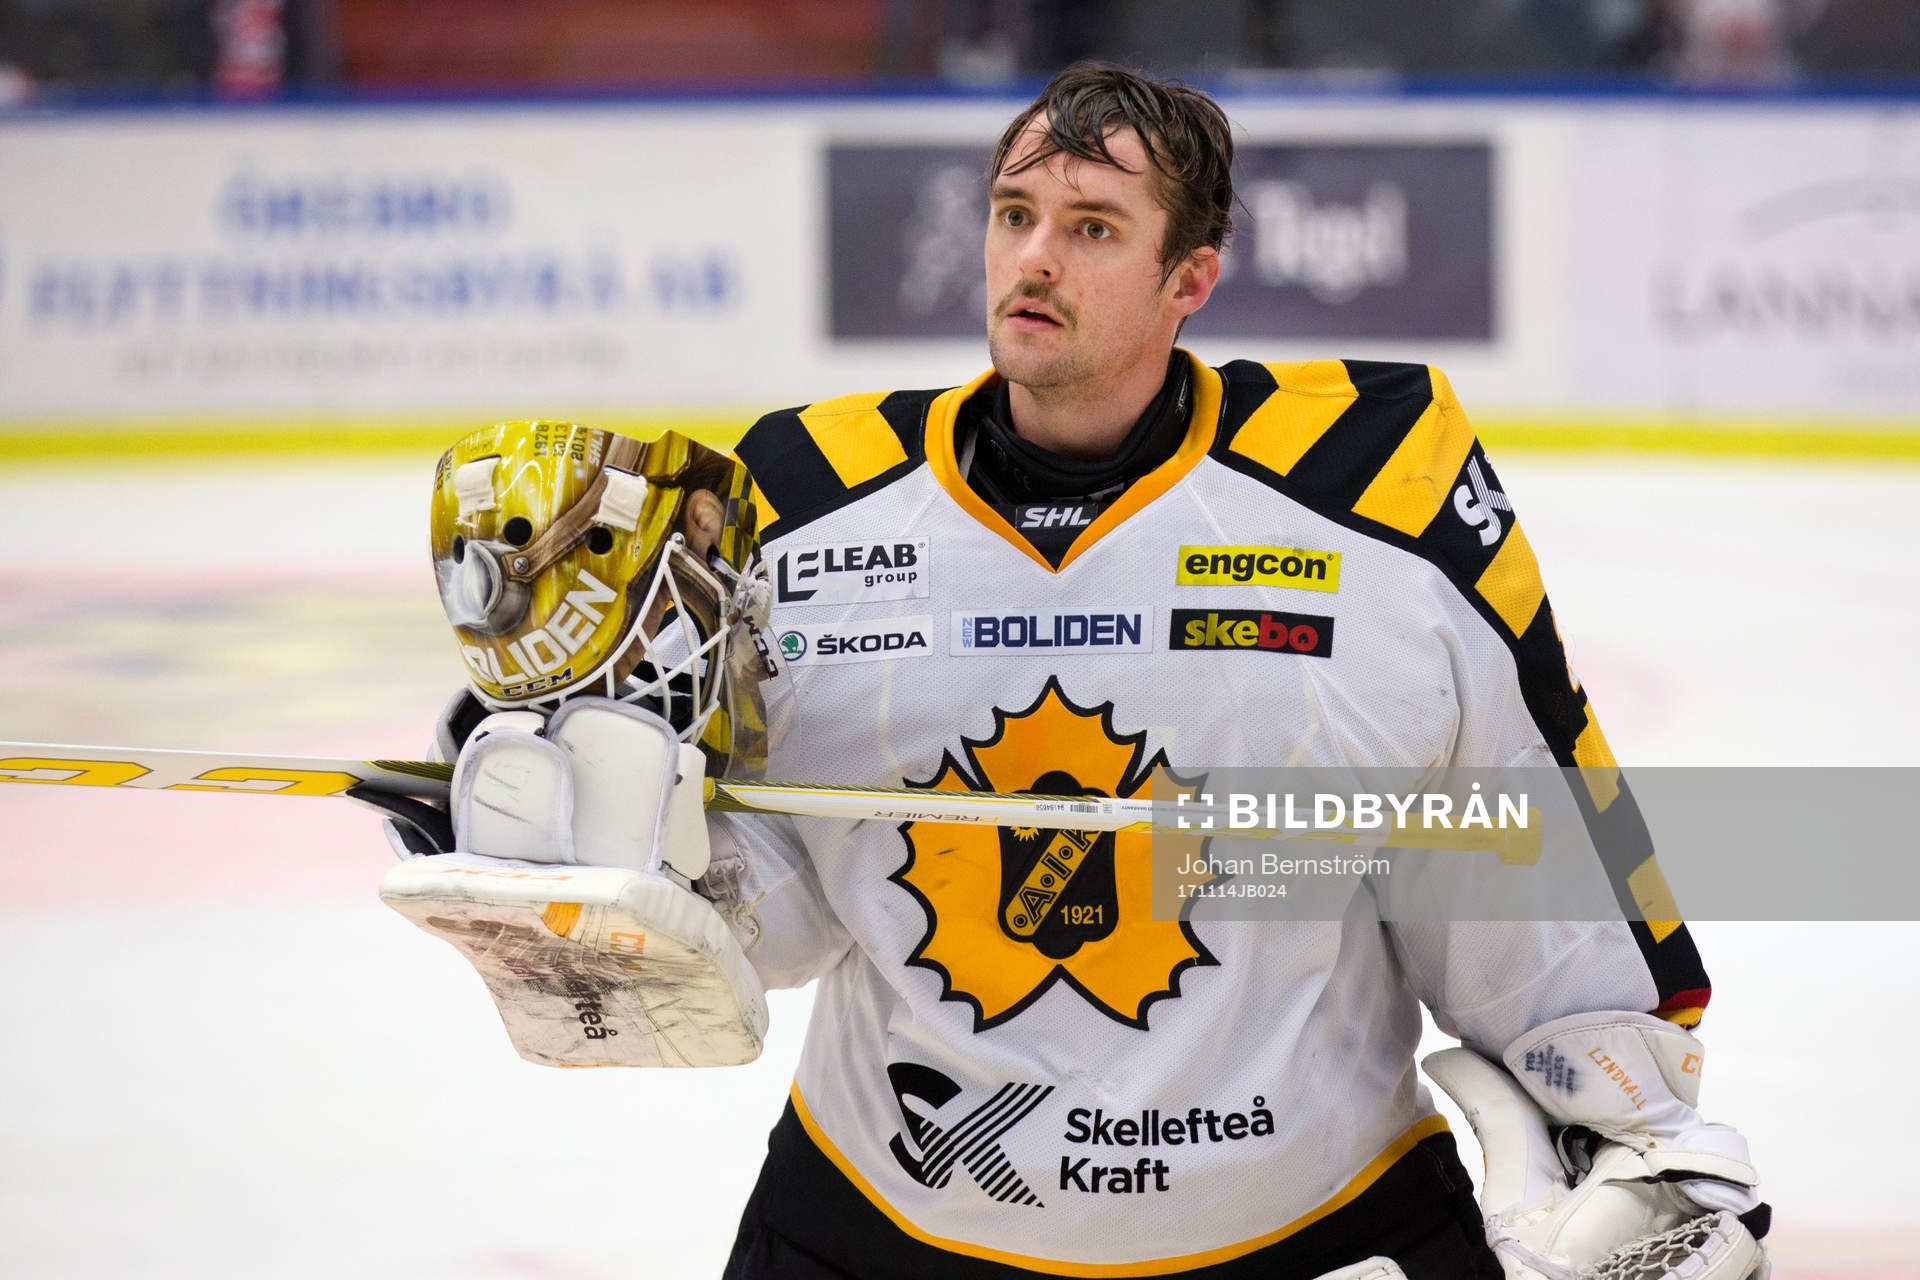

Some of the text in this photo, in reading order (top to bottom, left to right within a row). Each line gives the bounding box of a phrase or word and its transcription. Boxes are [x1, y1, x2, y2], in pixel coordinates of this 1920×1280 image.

[1021, 507, 1091, 528] SHL
[825, 543, 918, 573] LEAB
[1185, 551, 1327, 581] engcon
[864, 570, 918, 588] group
[817, 631, 927, 655] ŠKODA
[974, 614, 1142, 648] BOLIDEN
[1184, 612, 1319, 652] skebo
[502, 667, 573, 697] CCM
[1061, 904, 1104, 925] 1921
[1064, 1095, 1275, 1147] Skellefteå
[1060, 1155, 1170, 1194] Kraft
